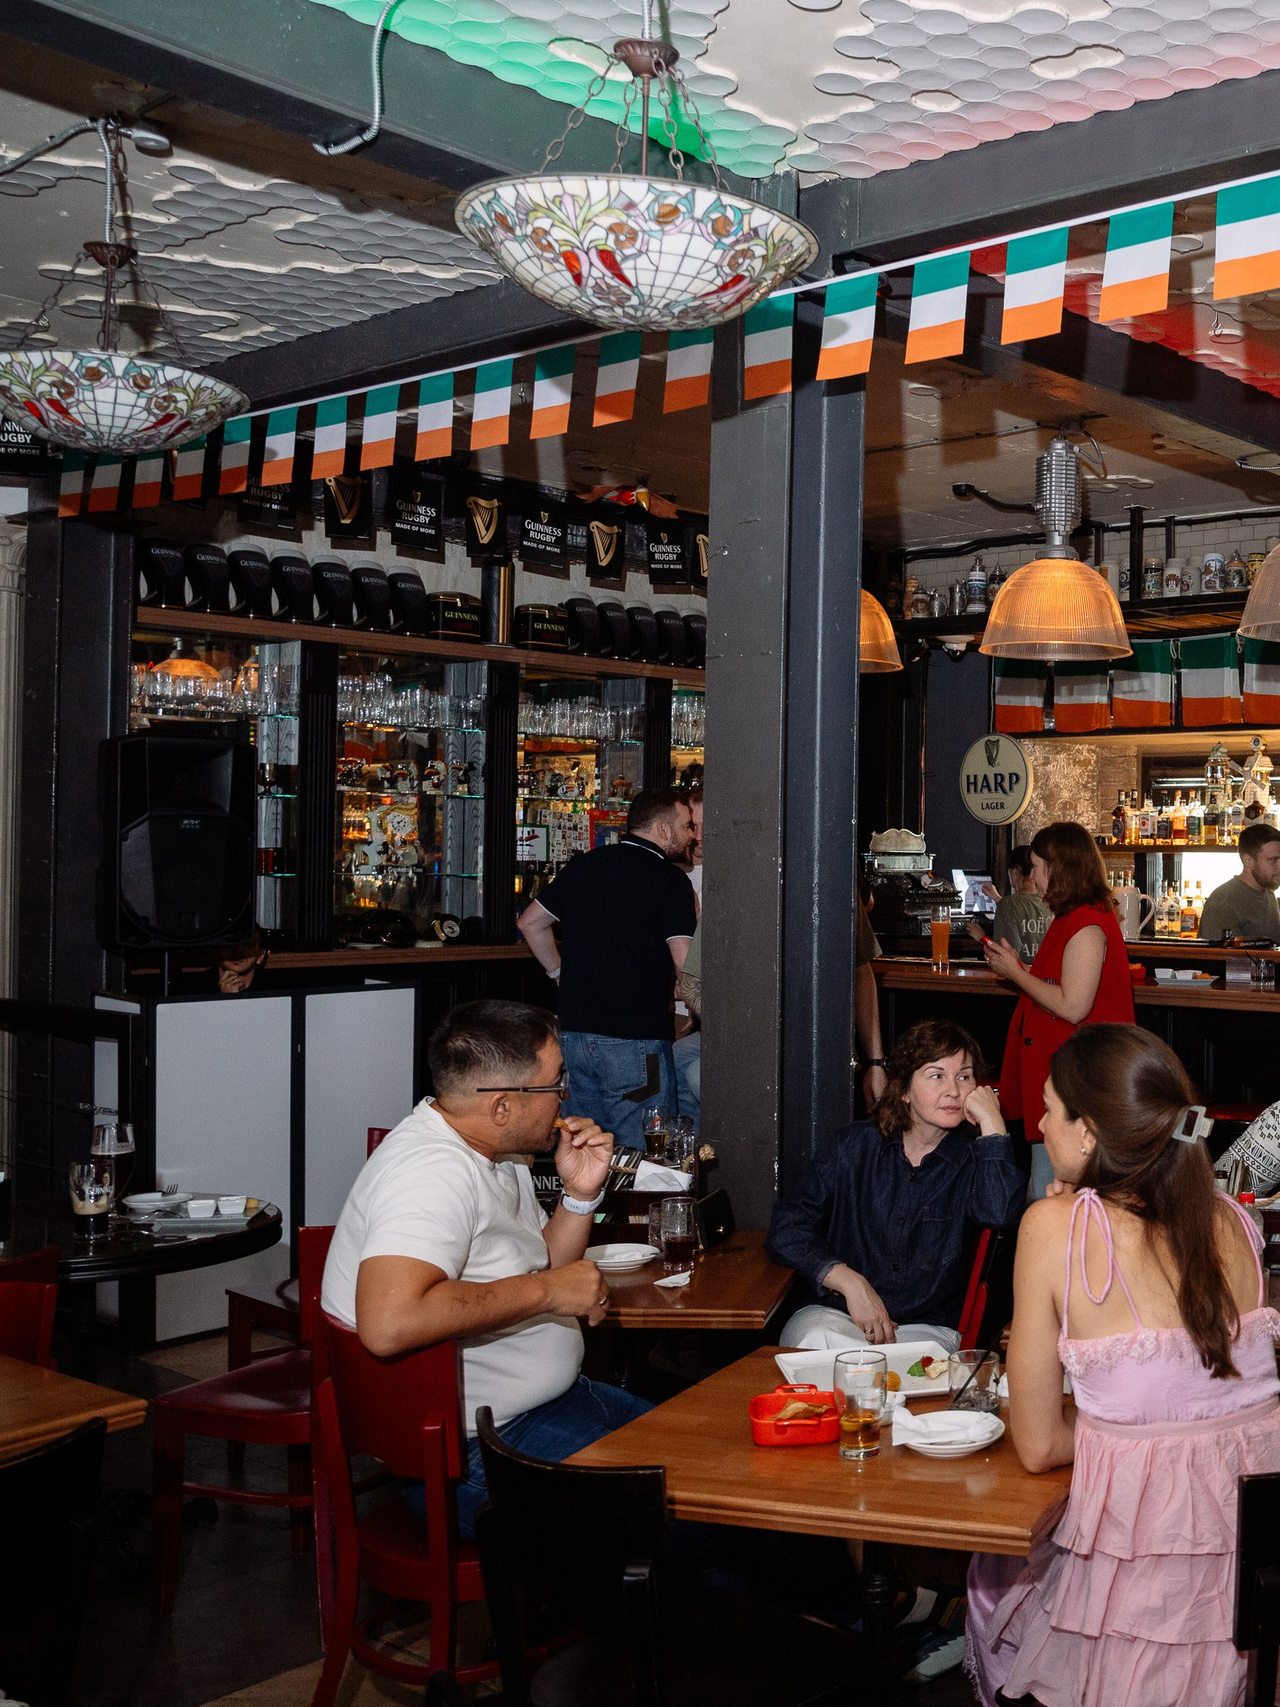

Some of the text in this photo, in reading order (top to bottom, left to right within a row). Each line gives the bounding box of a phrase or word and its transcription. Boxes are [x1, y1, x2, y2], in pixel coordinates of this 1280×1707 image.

[0, 433, 32, 444] UGBY
[250, 486, 284, 501] RUGBY
[396, 500, 437, 517] GUINNESS
[401, 511, 431, 525] RUGBY
[395, 522, 411, 531] MADE
[420, 527, 436, 535] MORE
[524, 519, 562, 537] GUINNESS
[529, 530, 557, 543] RUGBY
[523, 540, 537, 549] MADE
[545, 545, 561, 554] MORE
[650, 542, 682, 553] GUINNESS
[654, 553, 678, 561] RUGBY
[444, 611, 479, 621] GUINNESS
[534, 622, 566, 632] GUINNESS
[966, 772, 1021, 796] HARP
[981, 801, 1006, 811] LAGER
